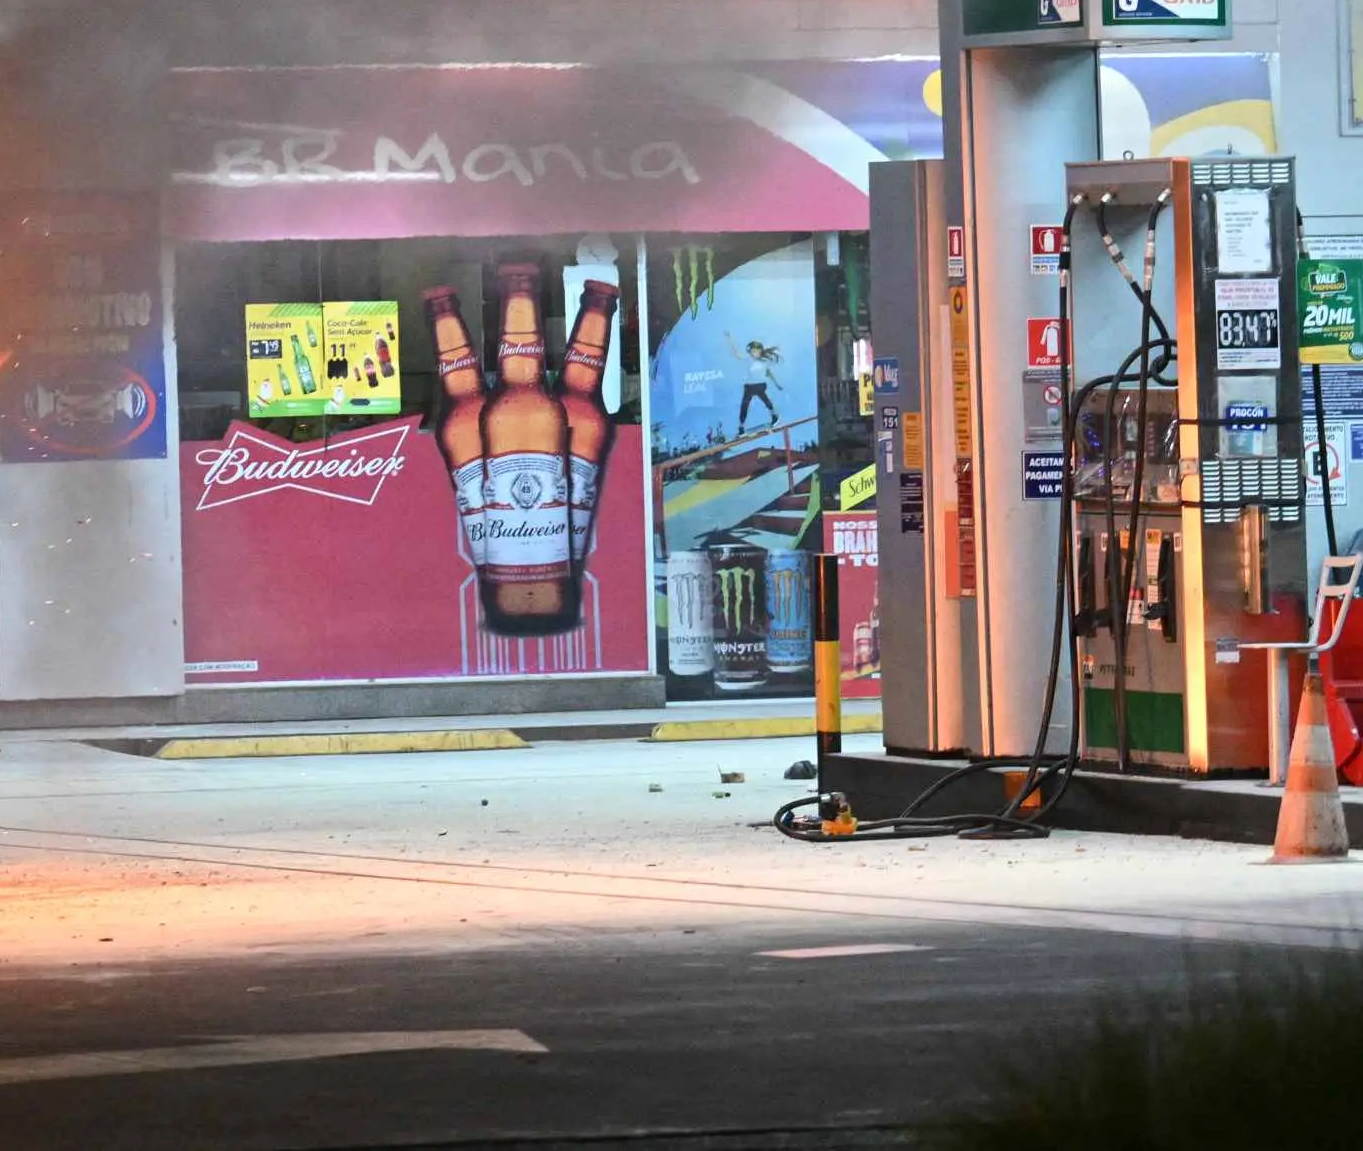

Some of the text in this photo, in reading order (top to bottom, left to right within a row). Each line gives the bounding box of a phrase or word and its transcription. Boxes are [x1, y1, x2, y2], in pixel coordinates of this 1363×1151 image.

[214, 131, 703, 187] BR Mania
[1303, 305, 1356, 327] 20 MIL
[248, 321, 292, 331] Heineken
[1229, 408, 1264, 417] PROCON
[883, 417, 898, 428] 151
[196, 447, 406, 485] Budweiser
[1038, 484, 1053, 494] VIA
[488, 519, 566, 539] Budweiser
